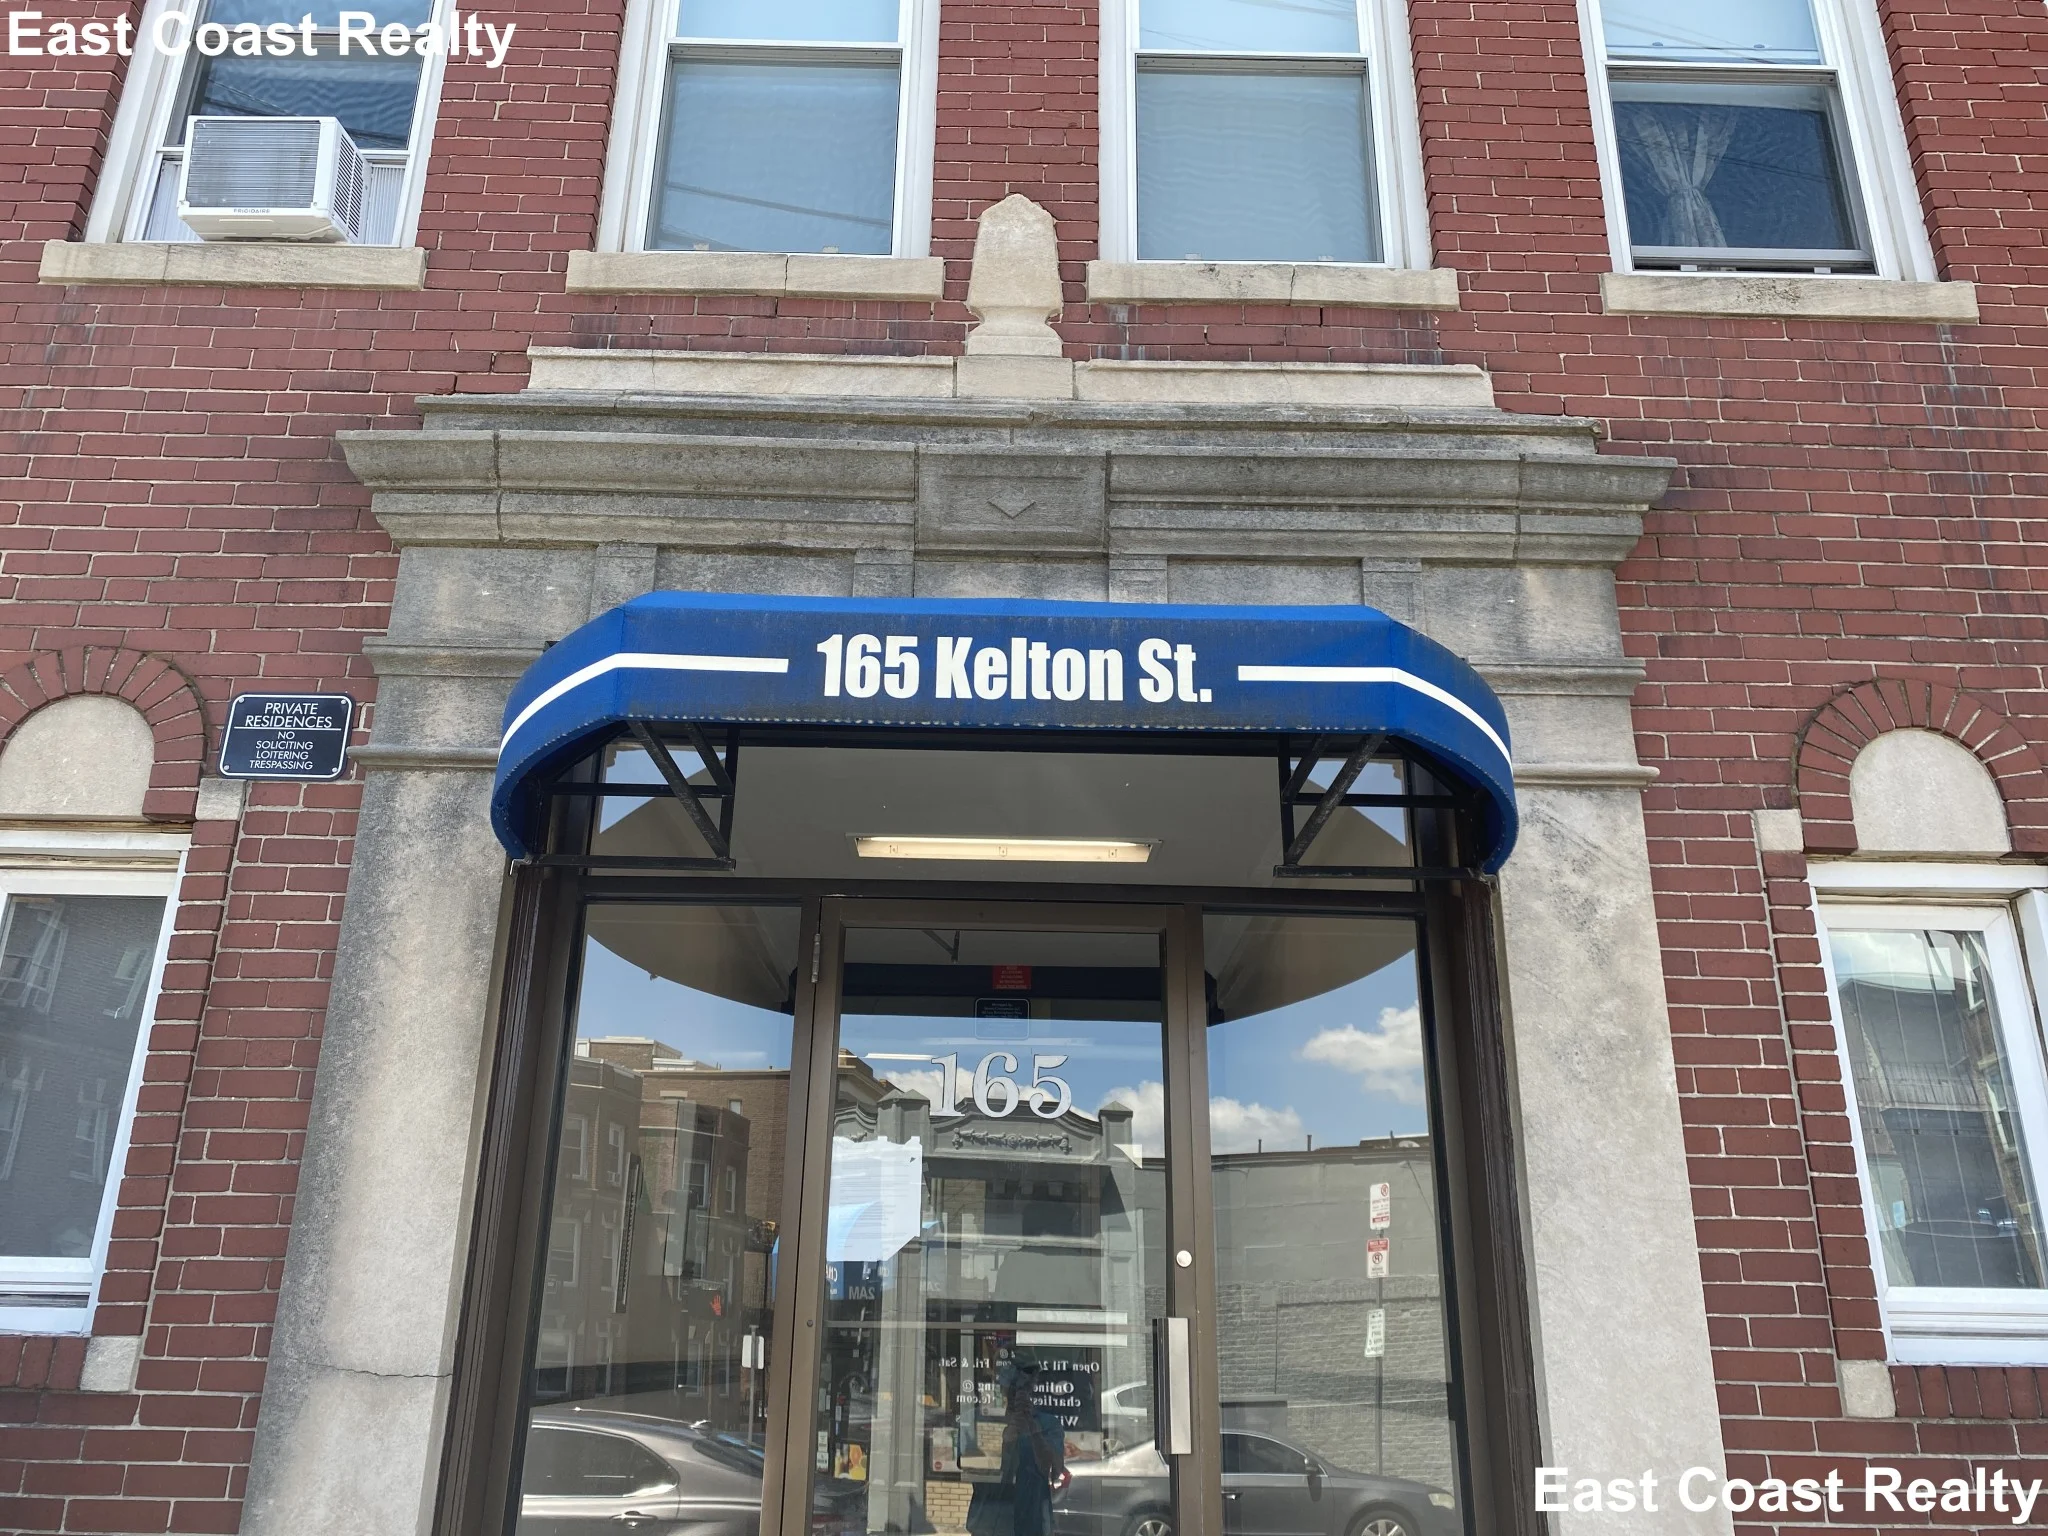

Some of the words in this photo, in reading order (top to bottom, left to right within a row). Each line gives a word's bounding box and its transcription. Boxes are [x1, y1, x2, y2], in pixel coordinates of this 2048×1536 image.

[816, 633, 920, 699] 165
[935, 636, 1124, 702] Kelton
[1138, 638, 1212, 703] St.
[264, 702, 319, 715] PRIVATE
[245, 715, 333, 728] RESIDENCES
[277, 731, 295, 740] NO
[255, 740, 314, 750] SOLICITING
[256, 750, 309, 760] LOITERING
[249, 760, 314, 770] TRESPASSING
[930, 1051, 1072, 1119] 165
